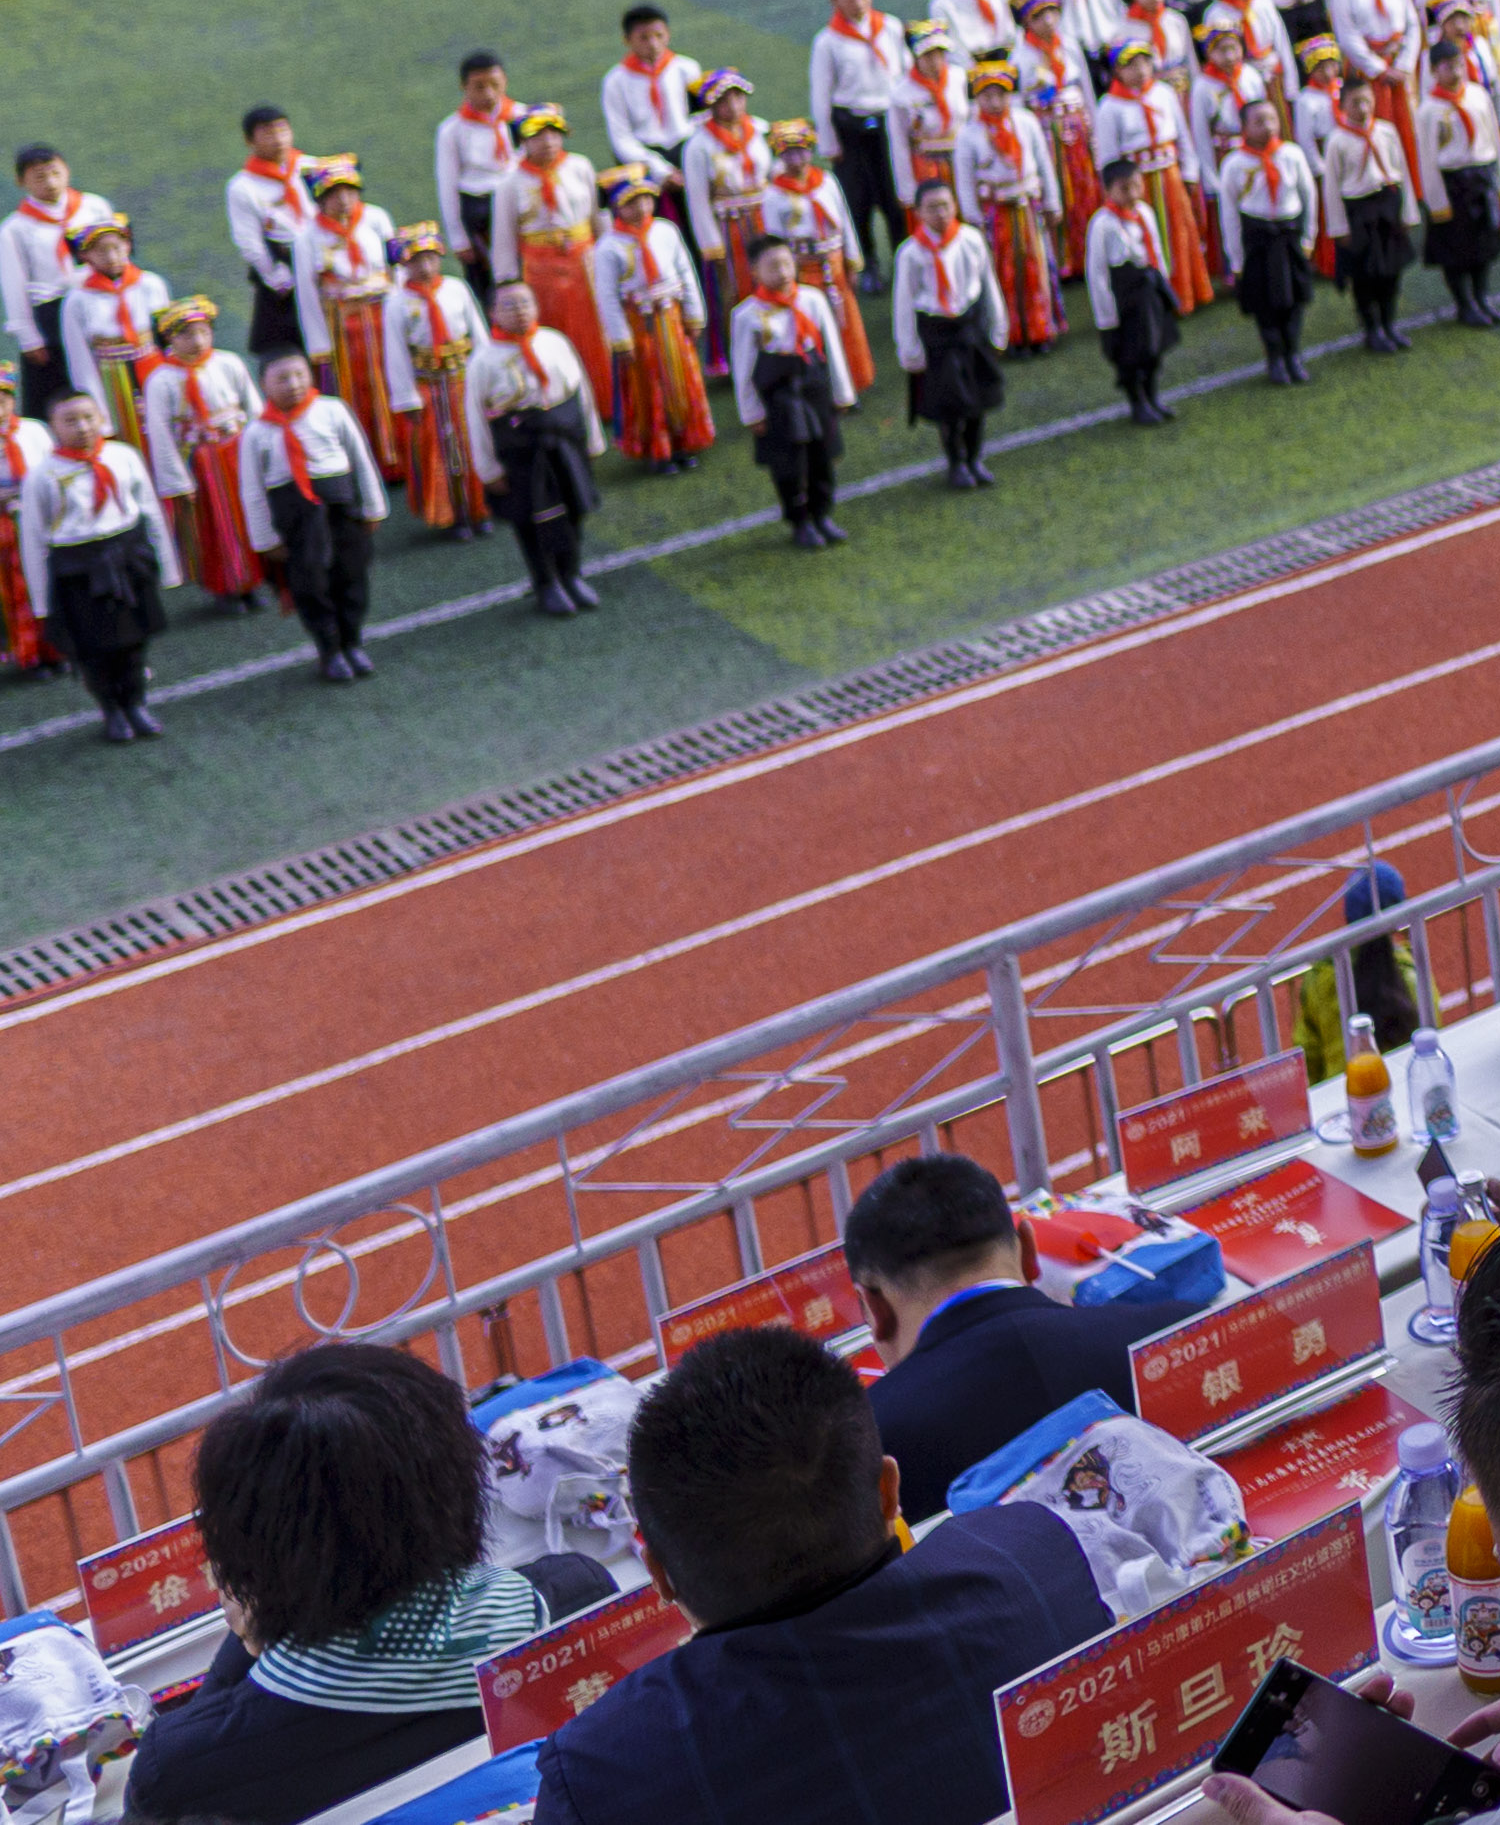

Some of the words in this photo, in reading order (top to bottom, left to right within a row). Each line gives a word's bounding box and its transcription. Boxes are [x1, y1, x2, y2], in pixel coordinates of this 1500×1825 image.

[1171, 1106, 1268, 1166] 阿来
[691, 1306, 738, 1337] 2021
[1168, 1330, 1223, 1371] 2021
[1200, 1318, 1328, 1408] 银勇
[119, 1545, 174, 1580] 2021
[525, 1637, 589, 1685] 2021
[1058, 1651, 1136, 1718] 2021
[1097, 1622, 1305, 1775] 斯旦珍
